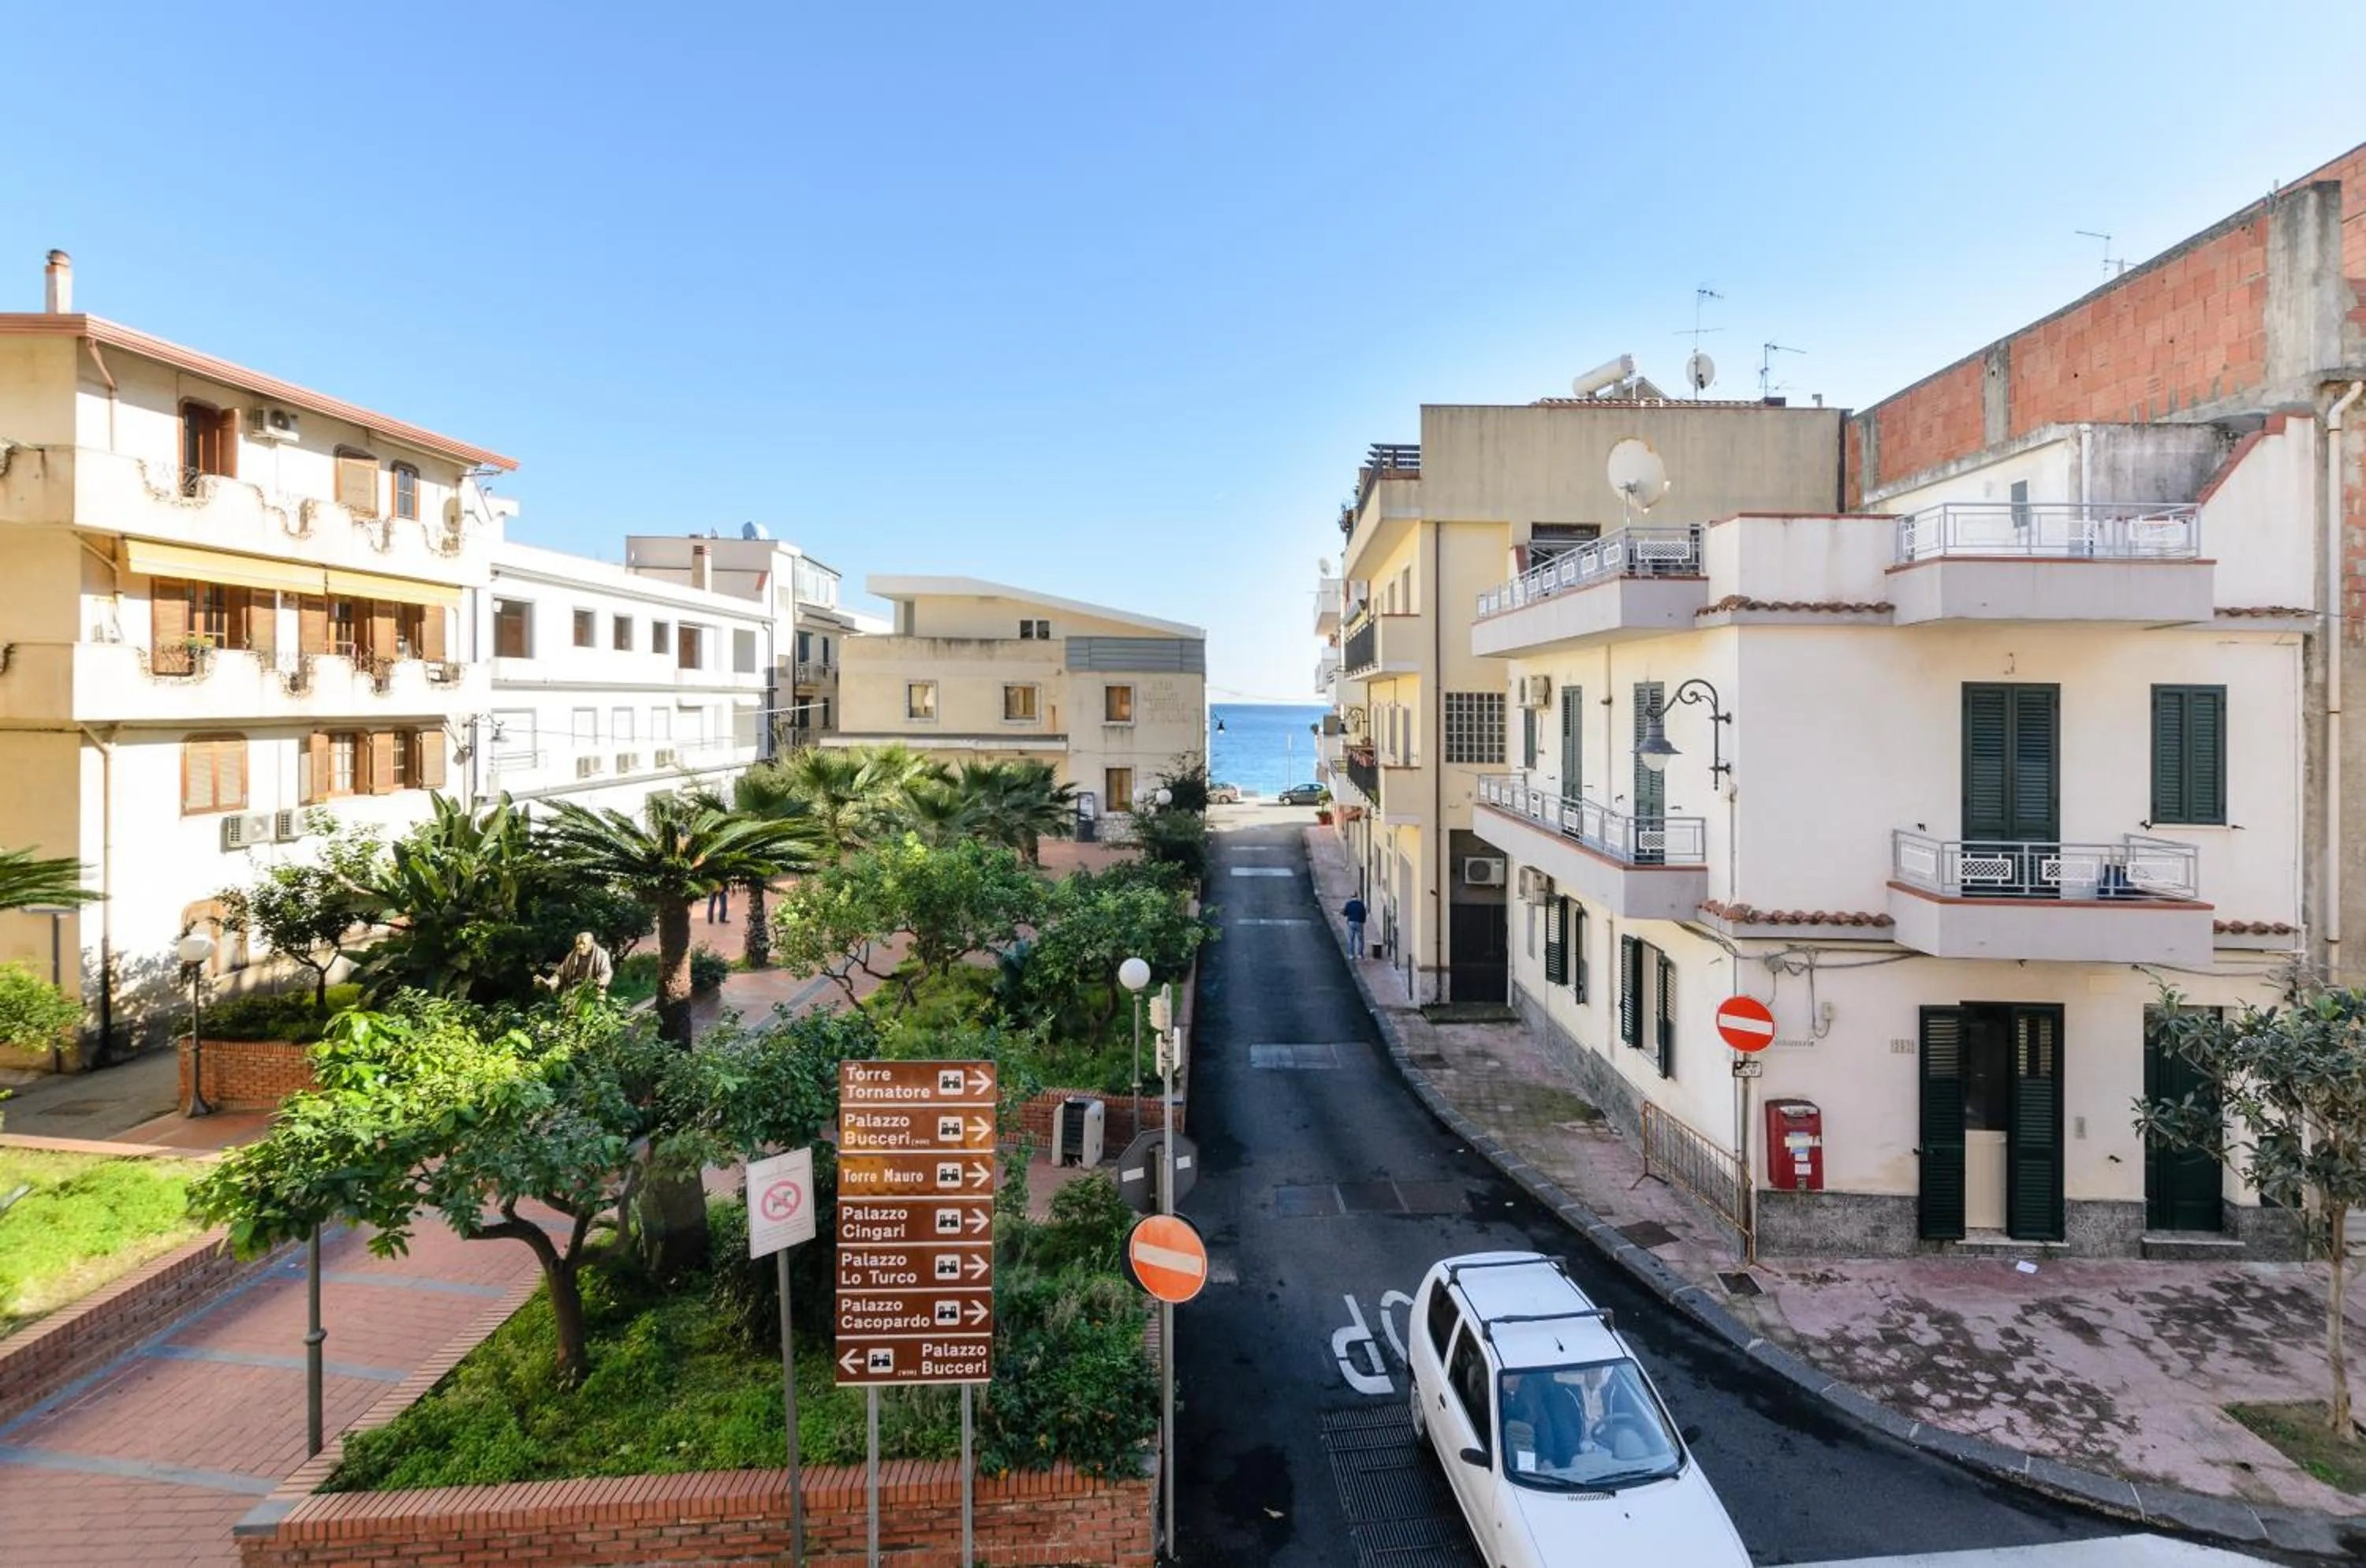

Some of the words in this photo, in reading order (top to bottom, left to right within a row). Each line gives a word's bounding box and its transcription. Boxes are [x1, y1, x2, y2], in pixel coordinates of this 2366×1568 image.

[845, 1067, 892, 1081] Torre
[845, 1085, 931, 1099] Tornatore
[845, 1114, 910, 1127] Palazzo
[844, 1131, 910, 1145] Bucceri
[843, 1169, 878, 1182] Torre
[883, 1168, 924, 1182] Mauro
[842, 1206, 908, 1220] Palazzo
[842, 1223, 905, 1241] Cingari
[841, 1252, 908, 1266] Palazzo
[841, 1271, 861, 1285] Lo
[868, 1270, 917, 1284] Turco
[841, 1298, 903, 1312] Palazzo
[841, 1314, 931, 1330] Cacopardo
[922, 1343, 987, 1357] Palazzo
[921, 1360, 987, 1375] Bucceri
